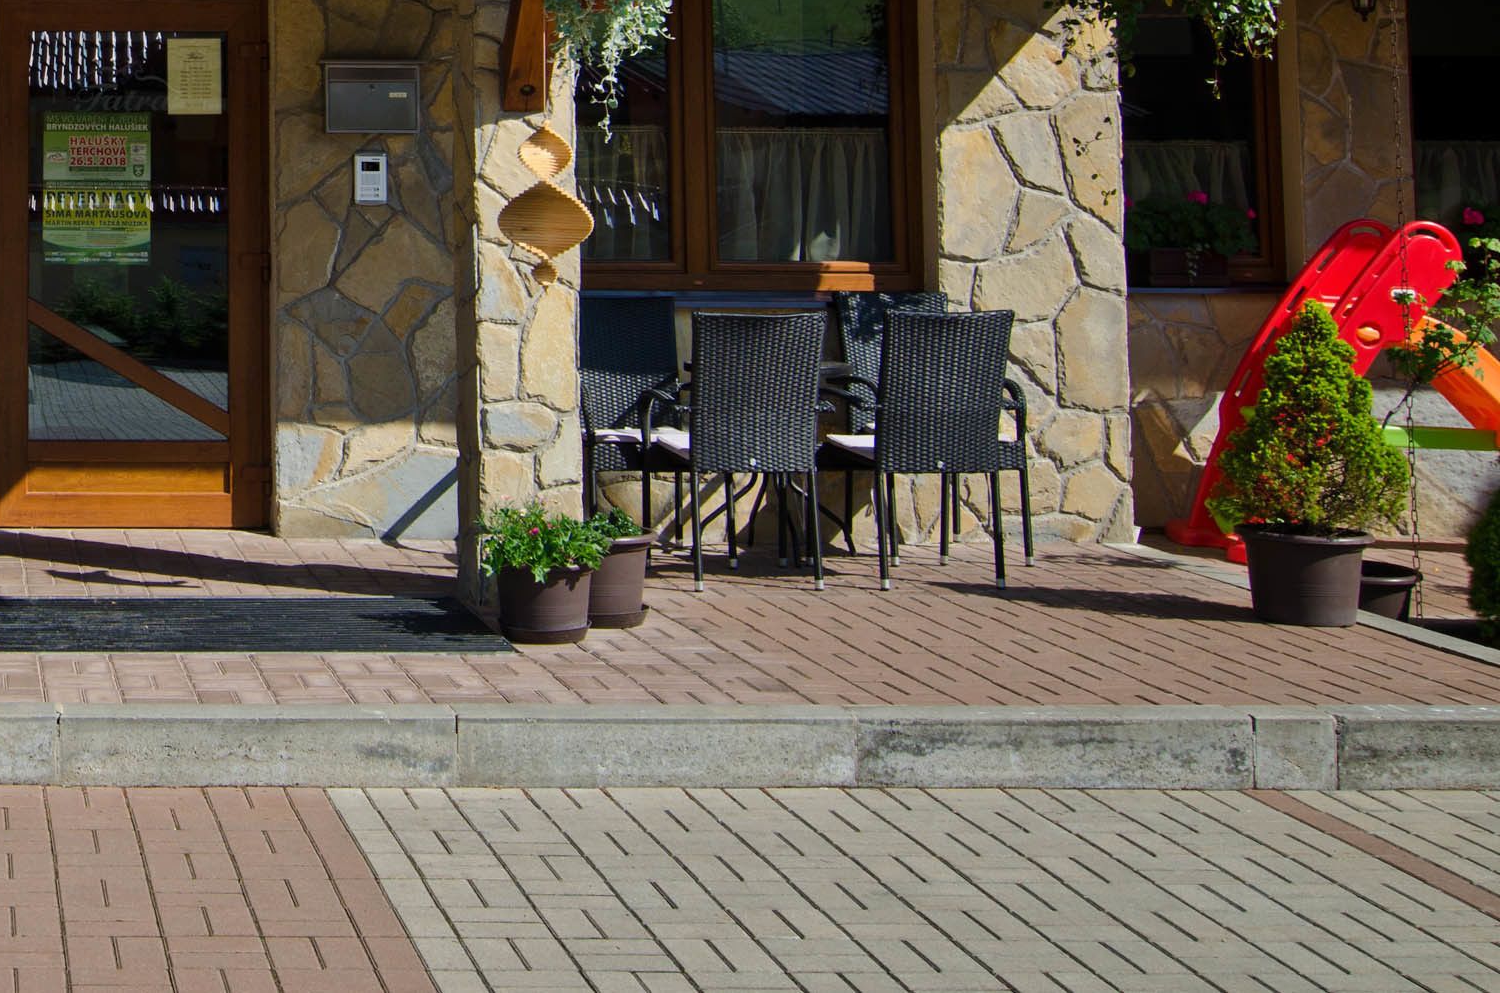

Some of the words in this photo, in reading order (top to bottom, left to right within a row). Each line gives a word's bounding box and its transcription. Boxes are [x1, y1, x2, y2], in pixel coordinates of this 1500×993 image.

[70, 135, 125, 145] HALUŠKY
[70, 157, 97, 166] 26.5.
[99, 157, 126, 166] 2018
